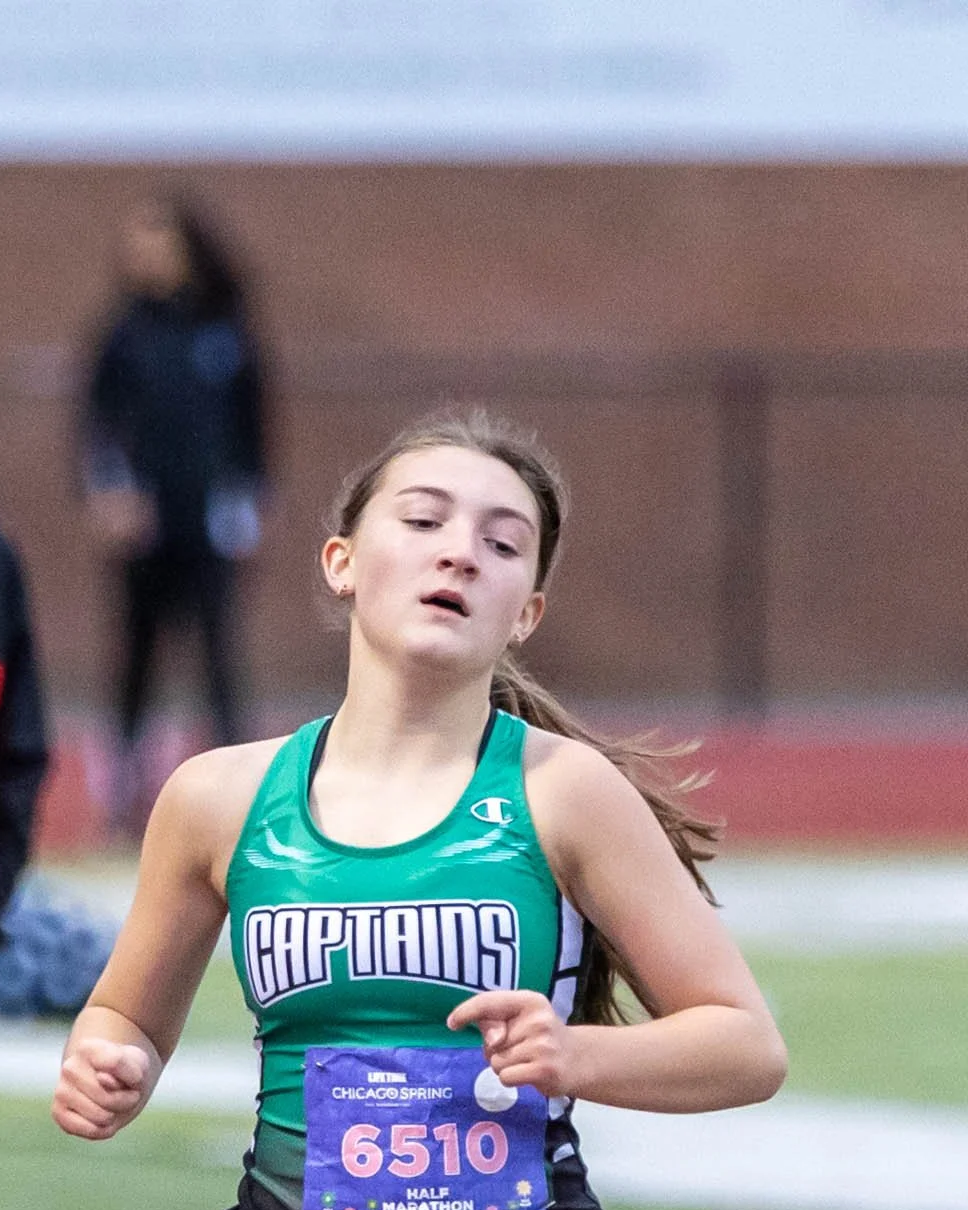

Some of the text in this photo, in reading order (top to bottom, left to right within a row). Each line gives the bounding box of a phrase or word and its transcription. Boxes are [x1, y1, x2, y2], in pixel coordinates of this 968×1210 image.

[244, 900, 519, 1008] CAPTAINS
[332, 1087, 453, 1100] CHICAGO SPRING
[341, 1121, 509, 1178] 6510
[406, 1187, 449, 1199] HALF
